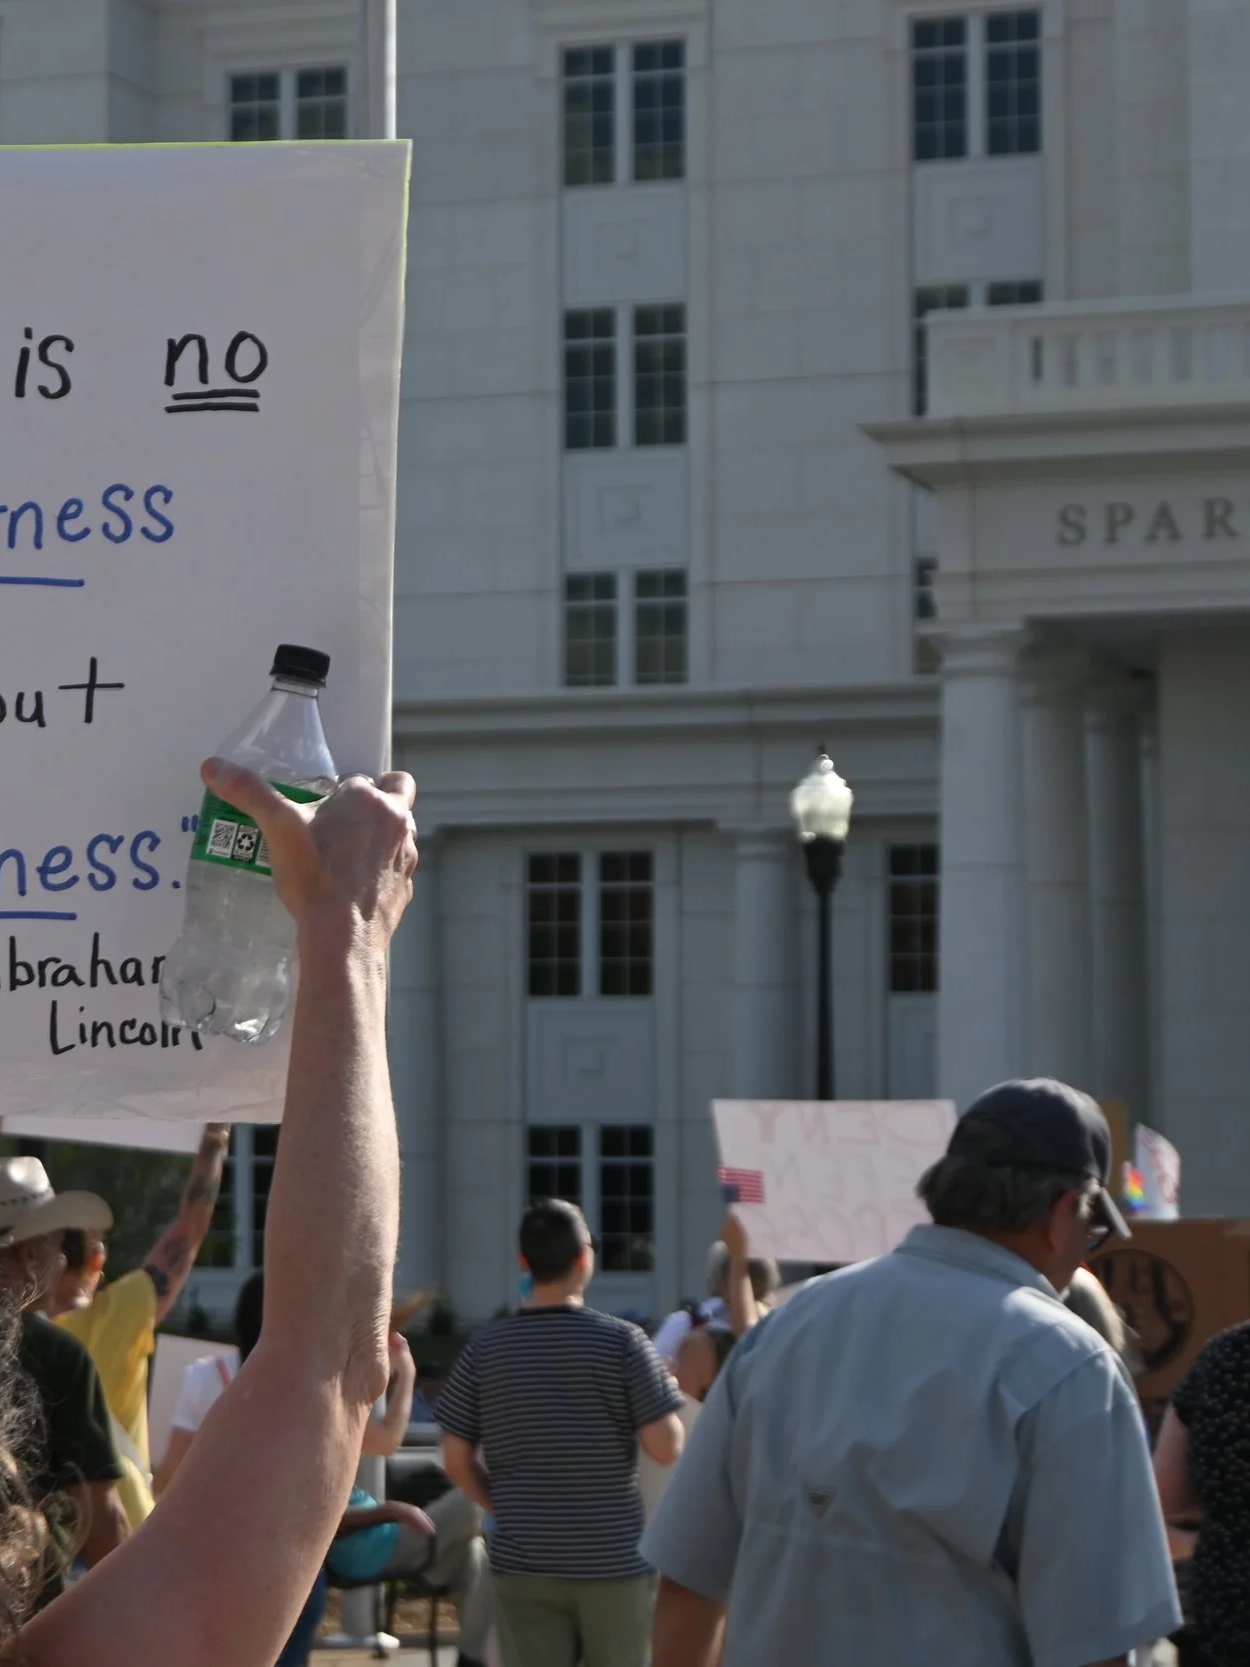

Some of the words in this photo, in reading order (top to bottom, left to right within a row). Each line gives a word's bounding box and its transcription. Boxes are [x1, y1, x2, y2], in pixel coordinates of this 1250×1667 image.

[14, 326, 75, 400] is
[163, 330, 268, 414] no
[1057, 497, 1239, 547] SPAR
